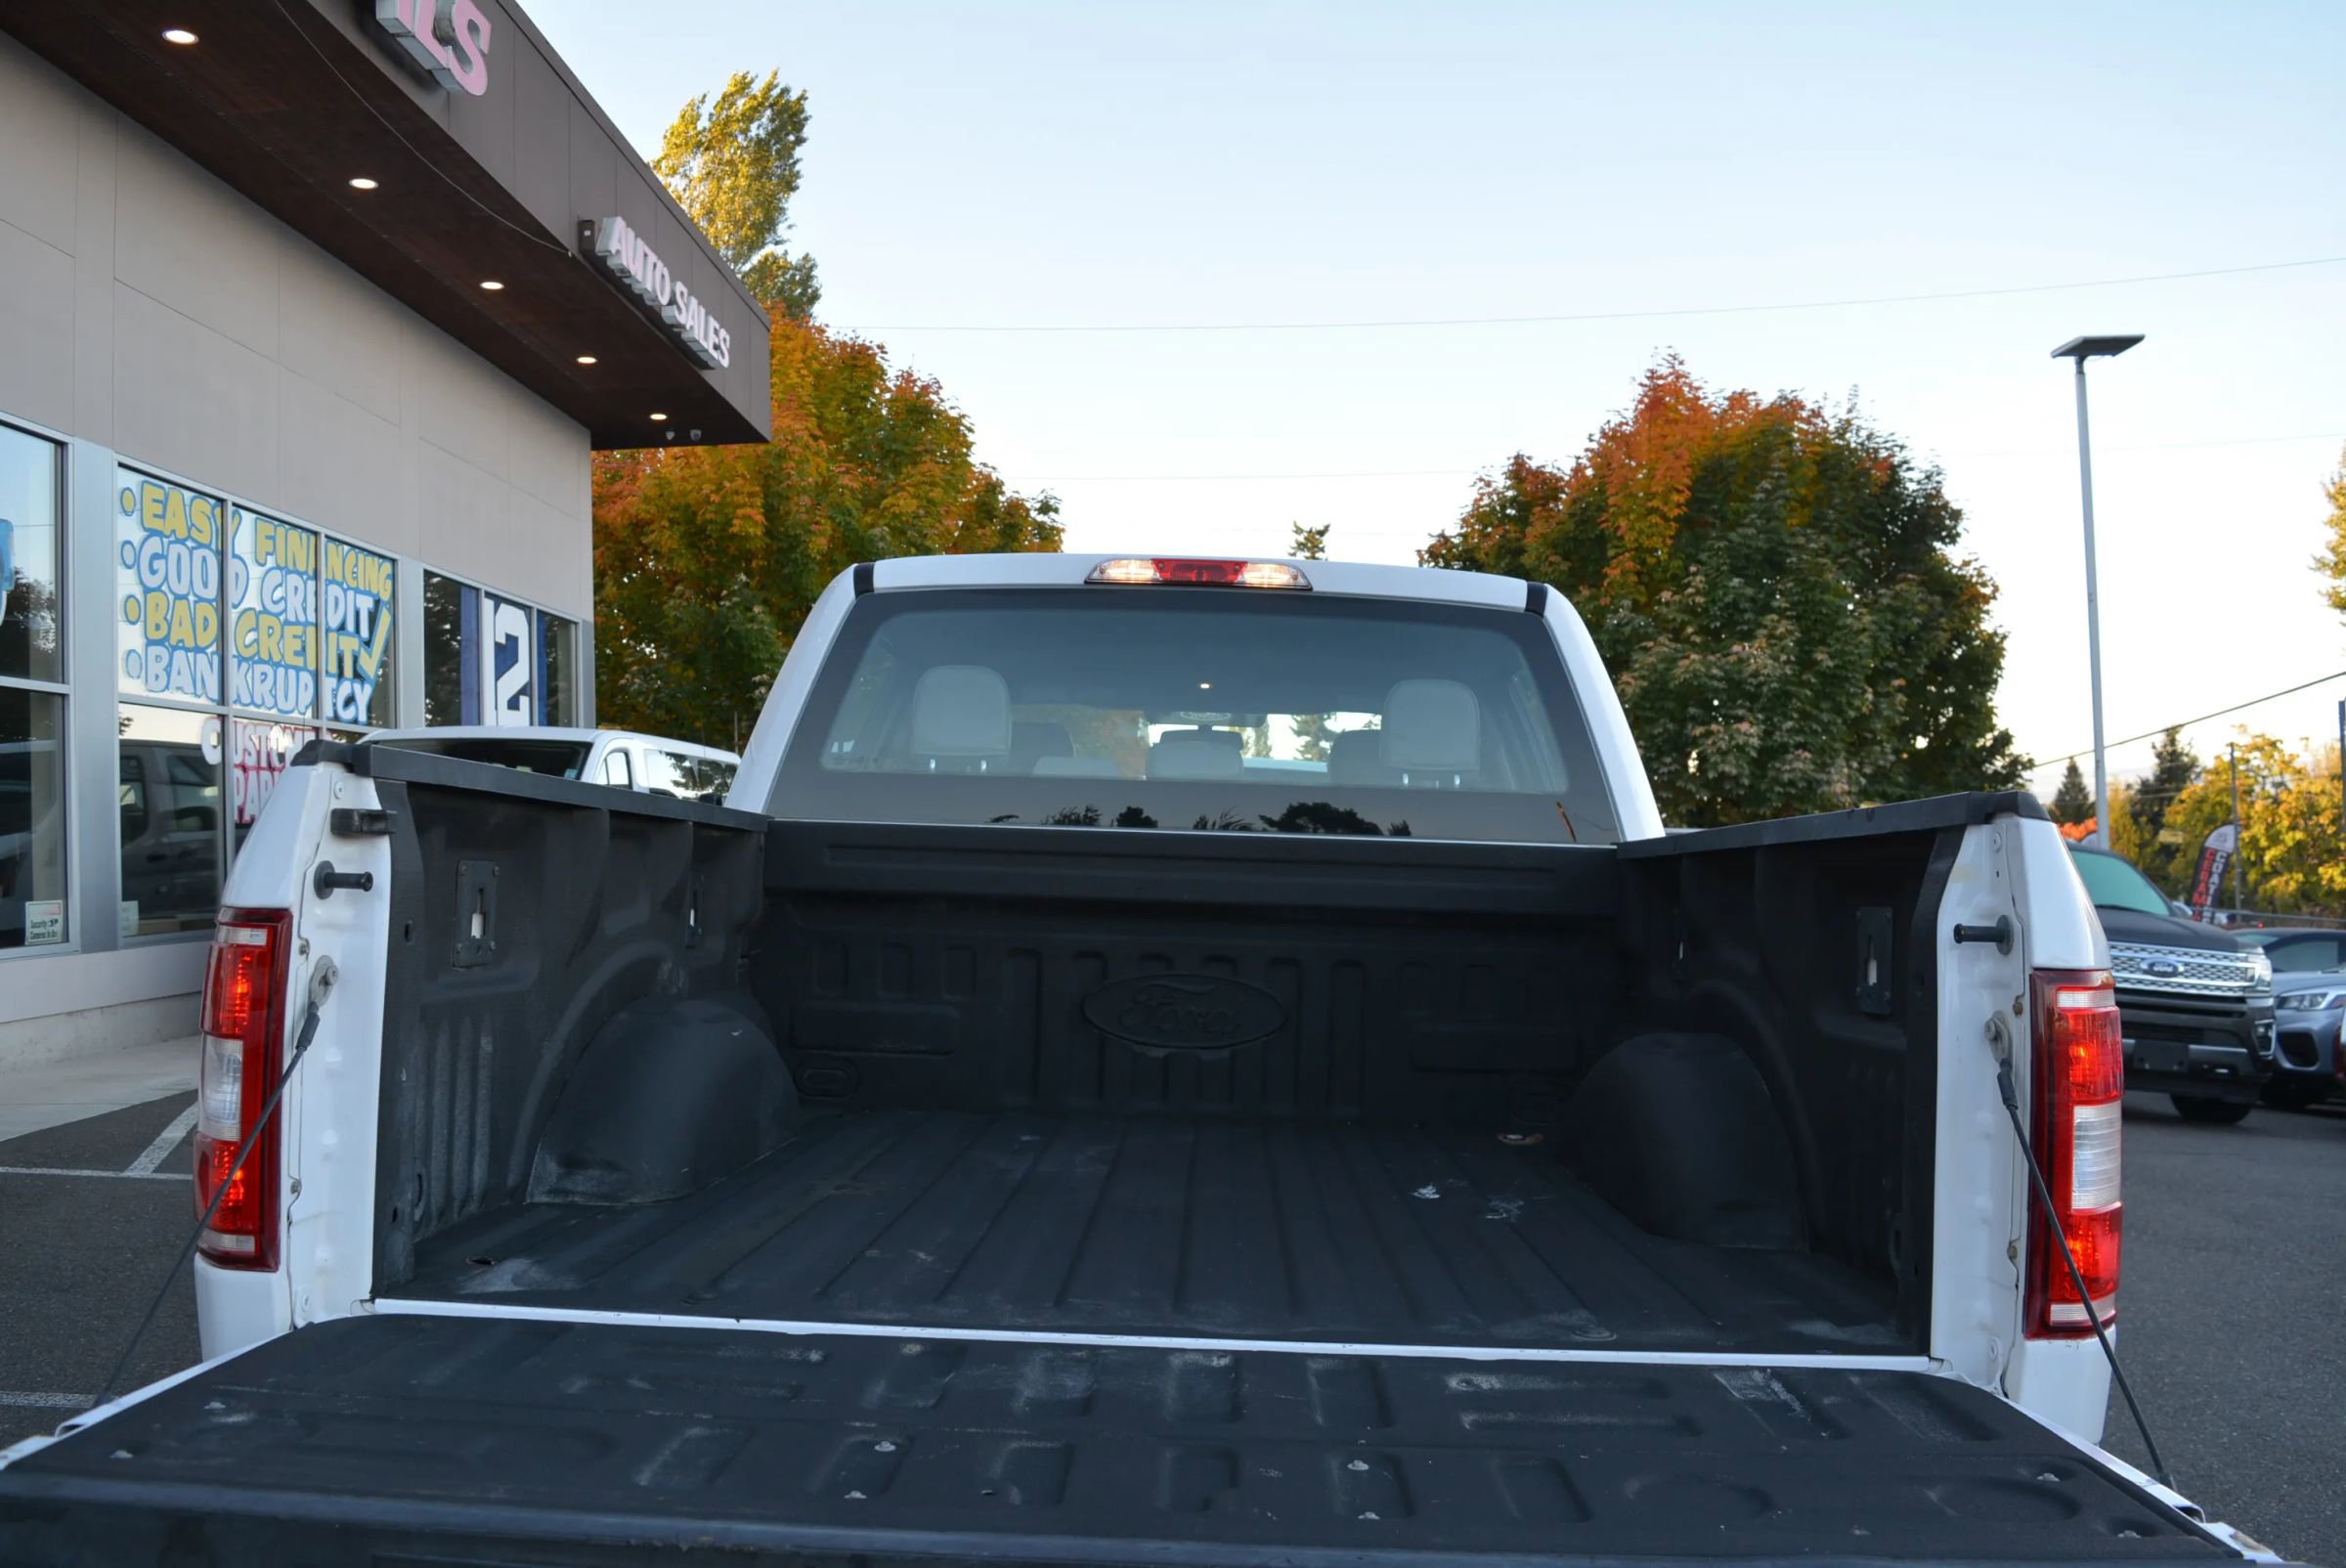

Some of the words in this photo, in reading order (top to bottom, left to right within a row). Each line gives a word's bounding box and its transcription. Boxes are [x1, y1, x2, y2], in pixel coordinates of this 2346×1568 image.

[596, 216, 672, 305] AUTO
[670, 281, 730, 369] SALES
[141, 480, 242, 553] EASY
[138, 534, 249, 609] GOOD
[145, 588, 218, 648] BAD
